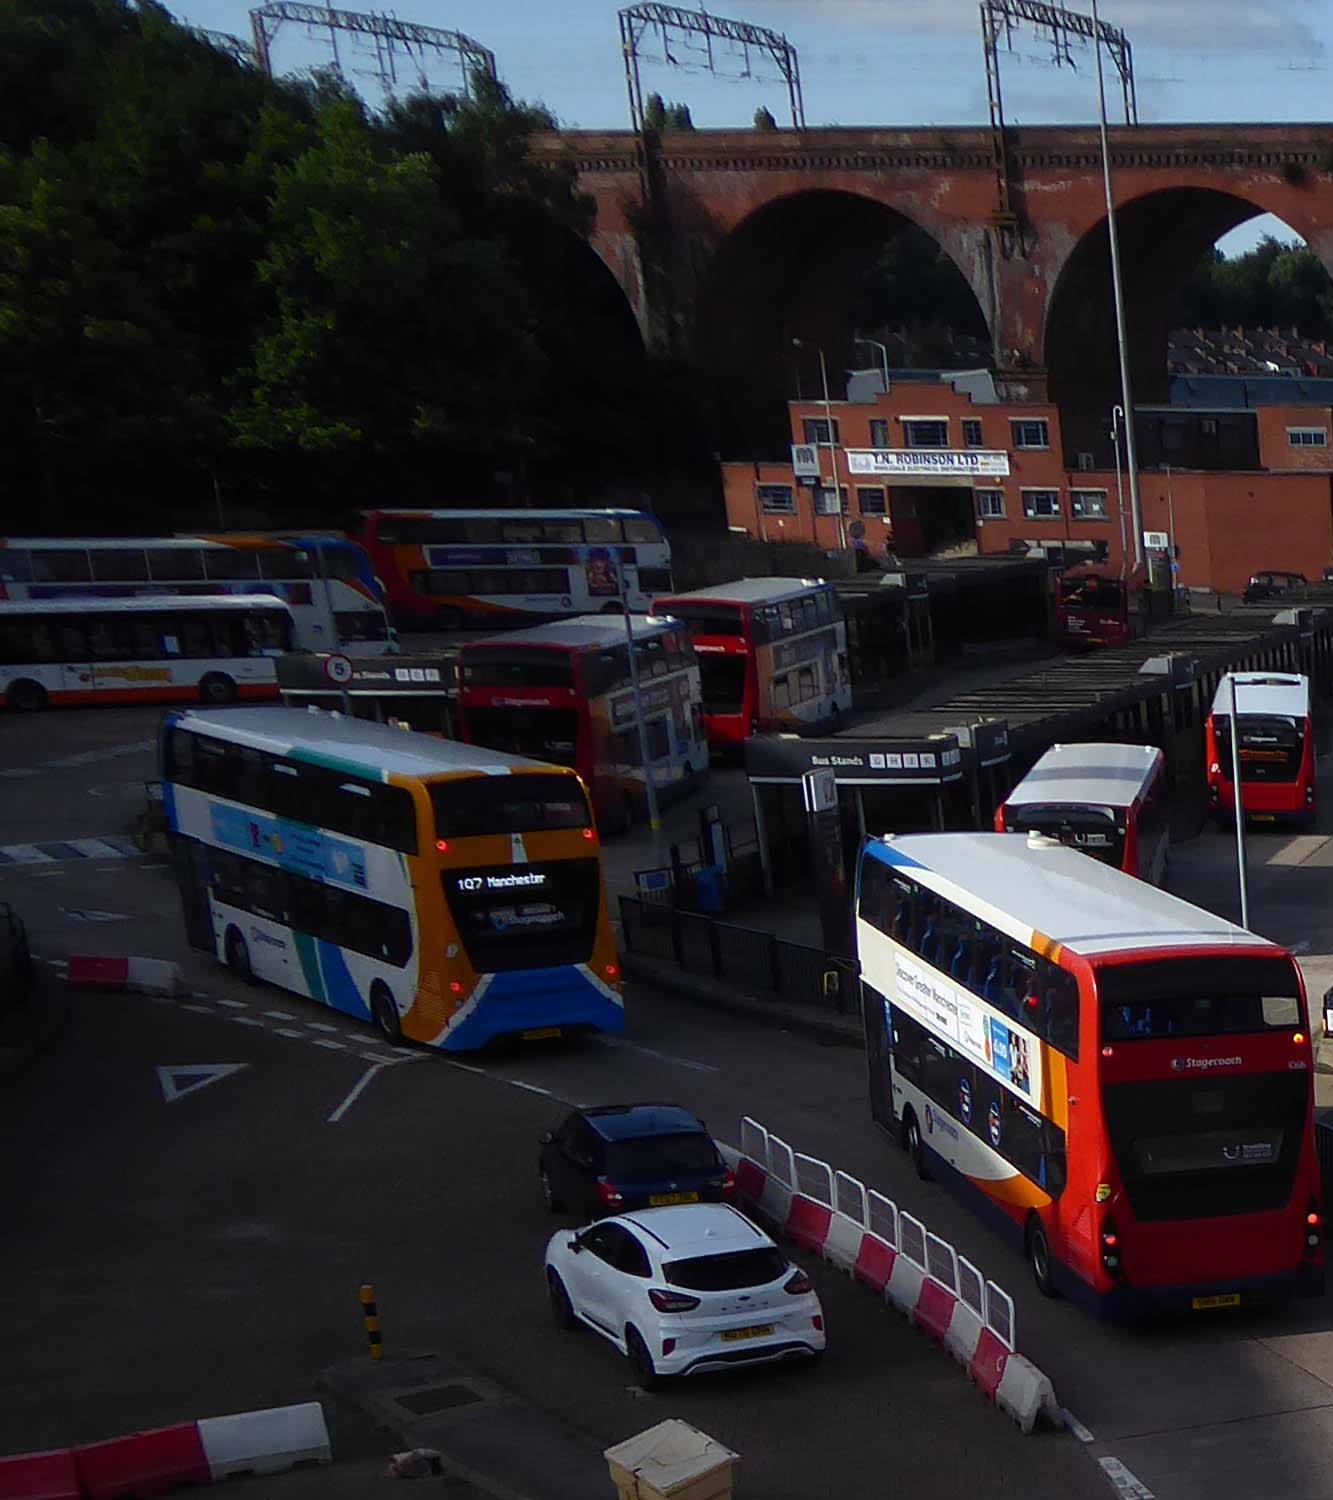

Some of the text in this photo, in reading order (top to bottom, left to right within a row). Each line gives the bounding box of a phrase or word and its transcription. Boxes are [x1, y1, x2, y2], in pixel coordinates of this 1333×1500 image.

[896, 452, 954, 466] ROBINSON
[957, 455, 979, 466] LTD
[334, 663, 344, 676] 5
[812, 755, 830, 766] Bus
[832, 756, 864, 767] Stands
[487, 873, 546, 888] Manchester
[1186, 1056, 1242, 1069] Stagecoach
